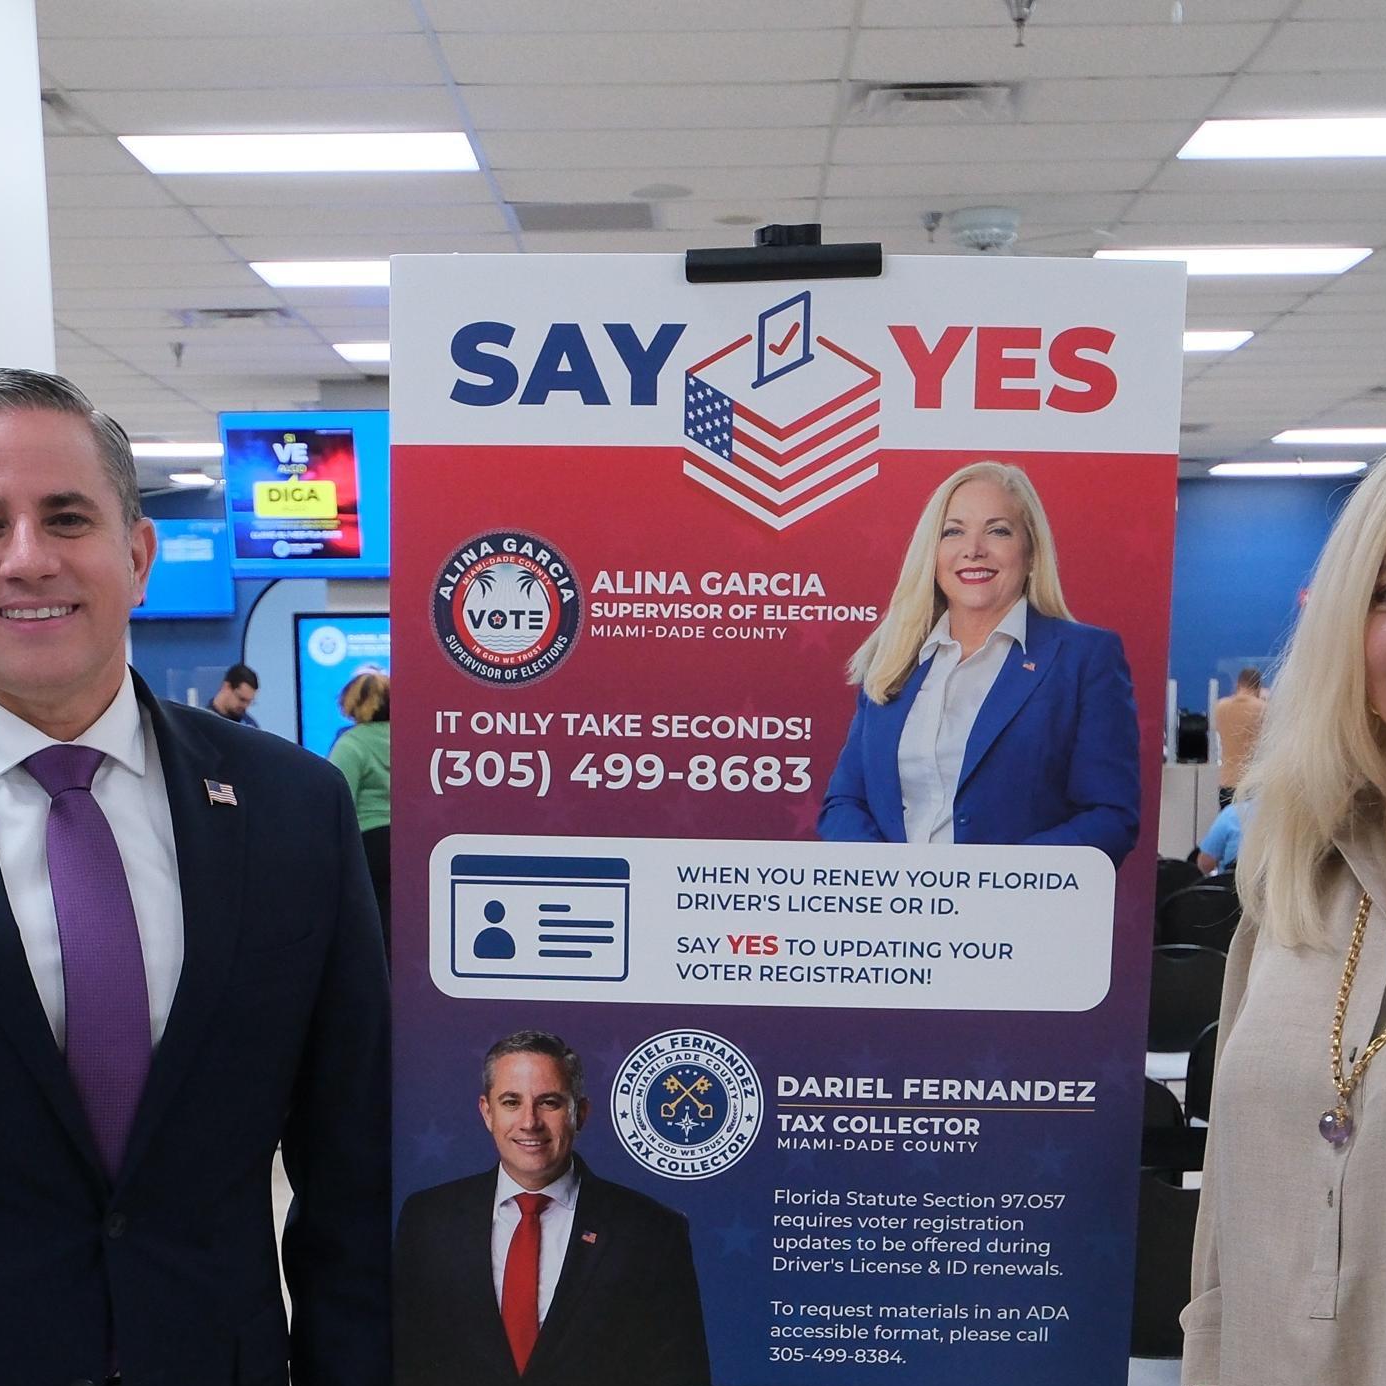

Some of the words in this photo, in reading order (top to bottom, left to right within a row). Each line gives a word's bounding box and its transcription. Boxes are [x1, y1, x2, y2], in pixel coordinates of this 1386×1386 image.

[450, 322, 687, 406] SAY
[887, 325, 1117, 413] YES
[272, 443, 309, 463] VE
[439, 541, 494, 600] ALINA
[502, 538, 575, 603] GARCIA
[462, 556, 515, 586] MIAMI-DADE
[518, 557, 552, 586] COUNTY
[591, 571, 691, 594] ALINA
[701, 572, 825, 596] GARCIA
[467, 609, 544, 630] VOTE
[591, 602, 722, 619] SUPERVISOR
[729, 604, 757, 619] OF
[764, 605, 877, 621] ELECTIONS
[592, 625, 705, 638] MIAMI-DADE
[713, 627, 787, 639] COUNTY
[445, 634, 501, 680] SUPERVISOR
[504, 668, 518, 680] OF
[521, 635, 568, 678] ELECTIONS
[472, 644, 481, 654] IN
[482, 650, 500, 663] GOD
[517, 645, 542, 662] TRUST
[436, 711, 462, 733] IT
[471, 712, 554, 735] ONLY
[561, 714, 641, 736] TAKE
[652, 715, 811, 740] SECONDS!
[430, 749, 550, 796] (305)
[570, 753, 811, 792] 499-8683
[677, 867, 749, 884] WHEN
[757, 868, 804, 885] YOU
[814, 869, 899, 886] RENEW
[906, 871, 970, 888] YOUR
[979, 872, 1078, 889] FLORIDA
[678, 893, 780, 911] DRIVER'S
[789, 896, 882, 913] LICENSE
[890, 898, 922, 914] OR
[931, 898, 958, 914] ID.
[678, 937, 720, 953] SAY
[727, 935, 778, 955] YES
[785, 939, 815, 956] TO
[824, 940, 941, 958] UPDATING
[949, 942, 1012, 959] YOUR
[677, 963, 751, 981] VOTER
[760, 966, 931, 984] REGISTRATION!
[619, 1043, 665, 1096] DARIEL
[670, 1036, 755, 1099] FERNANDEZ
[636, 1053, 700, 1098] MIAMI-DADE
[705, 1058, 739, 1100] COUNTY
[778, 1076, 892, 1098] DARIEL
[904, 1079, 1095, 1101] FERNANDEZ
[777, 1115, 825, 1132] TAX
[833, 1116, 980, 1135] COLLECTOR
[627, 1130, 654, 1160] TAX
[656, 1132, 748, 1173] COLLECTOR
[647, 1133, 656, 1143] IN
[657, 1142, 677, 1155] GOD
[699, 1135, 725, 1155] TRUST
[778, 1138, 894, 1151] MIAMI-DADE
[903, 1140, 977, 1152] COUNTY
[775, 1189, 839, 1205] Florida
[847, 1191, 917, 1206] Statute
[923, 1193, 994, 1208] Section
[774, 1212, 852, 1230] requires
[858, 1216, 907, 1229] voter
[914, 1215, 1023, 1233] registration
[774, 1235, 851, 1252] updates
[857, 1237, 876, 1250] to
[883, 1237, 906, 1251] be
[912, 1237, 980, 1252] offered
[987, 1238, 1050, 1257] during
[773, 1257, 843, 1272] Driver's
[851, 1258, 922, 1273] License
[928, 1260, 940, 1274] &
[948, 1261, 967, 1274] ID
[974, 1261, 1062, 1275] renewals.
[770, 1301, 793, 1315] To
[800, 1305, 872, 1320] request
[880, 1304, 968, 1318] materials
[975, 1304, 990, 1319] in
[998, 1309, 1020, 1319] an
[1026, 1306, 1069, 1320] ADA
[771, 1324, 868, 1339] accessible
[874, 1325, 943, 1342] format,
[950, 1326, 1011, 1344] please
[1016, 1327, 1048, 1341] call
[770, 1347, 906, 1363] 305-499-8384.
